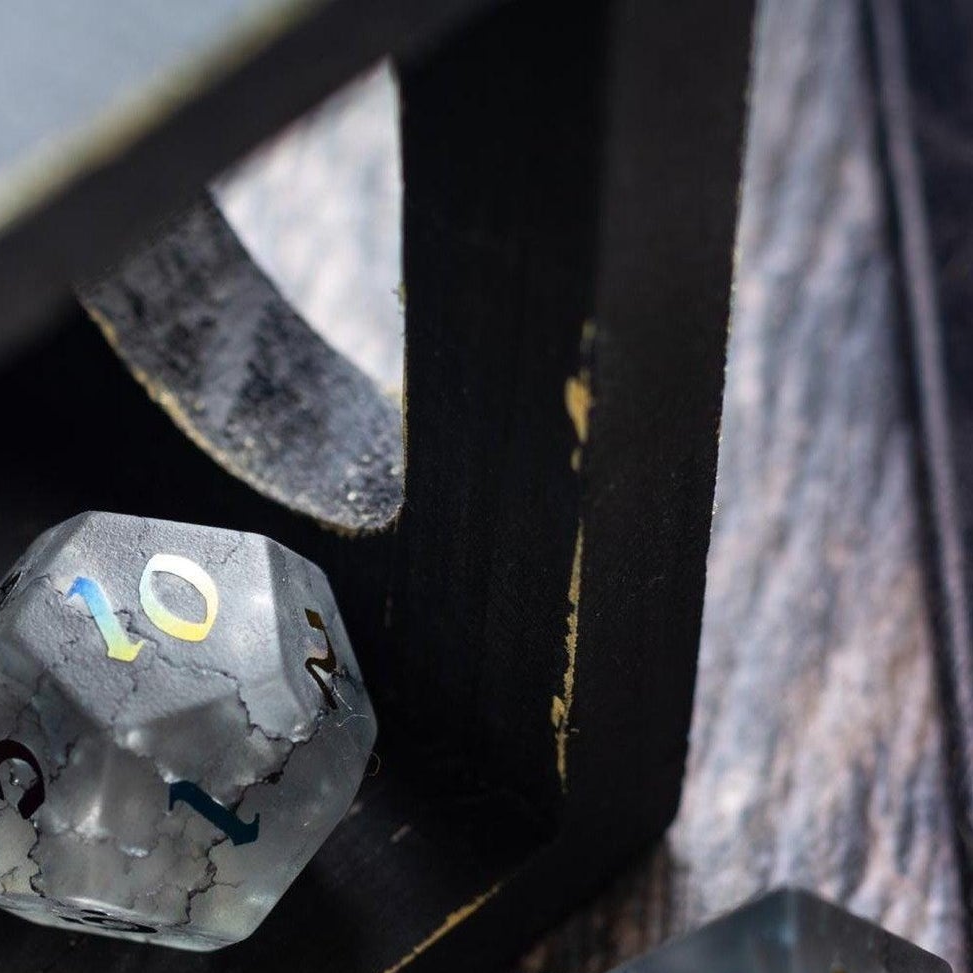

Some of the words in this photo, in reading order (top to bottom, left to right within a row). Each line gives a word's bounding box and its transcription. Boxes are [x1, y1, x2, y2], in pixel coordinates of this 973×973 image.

[67, 553, 219, 662] 10
[304, 607, 339, 710] 2
[168, 780, 260, 846] 1
